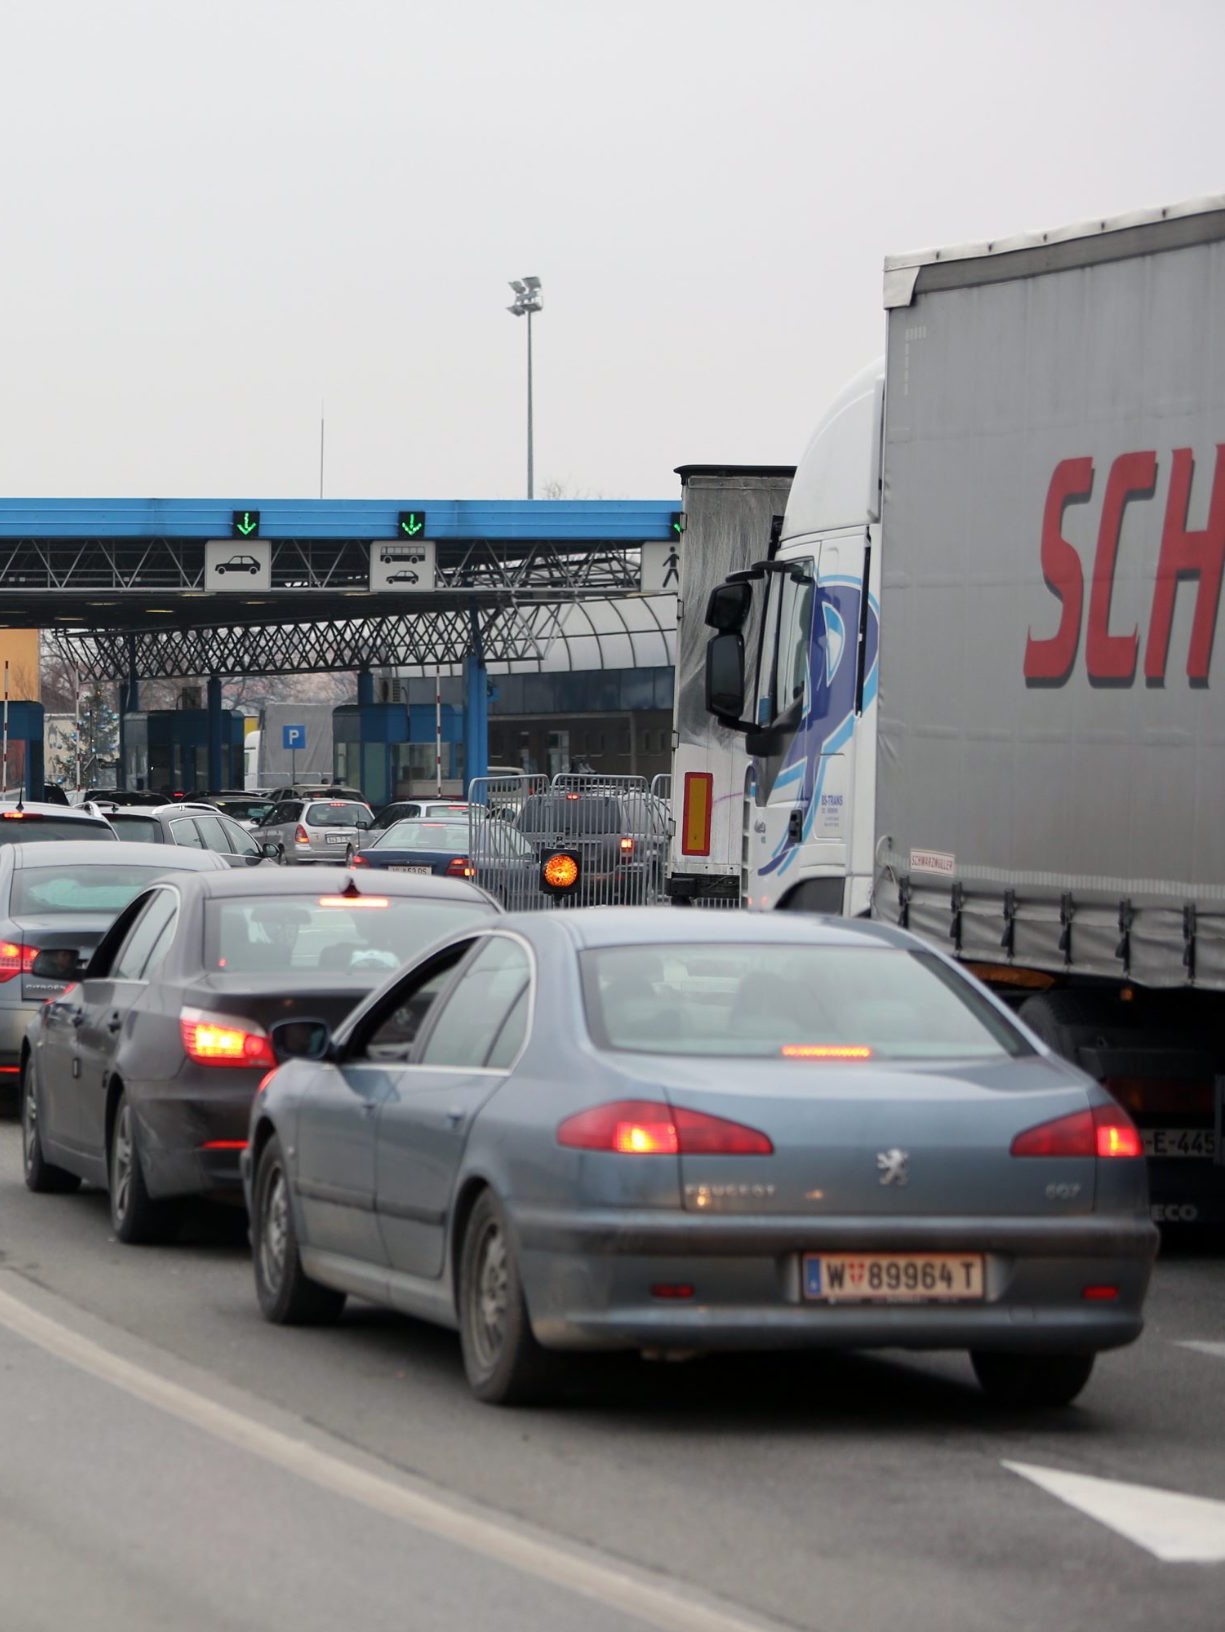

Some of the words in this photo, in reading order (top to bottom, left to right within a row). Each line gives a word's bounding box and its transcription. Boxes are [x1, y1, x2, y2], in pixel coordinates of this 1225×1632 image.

[1023, 444, 1225, 689] SCH
[289, 729, 300, 745] P
[827, 1262, 846, 1290] W
